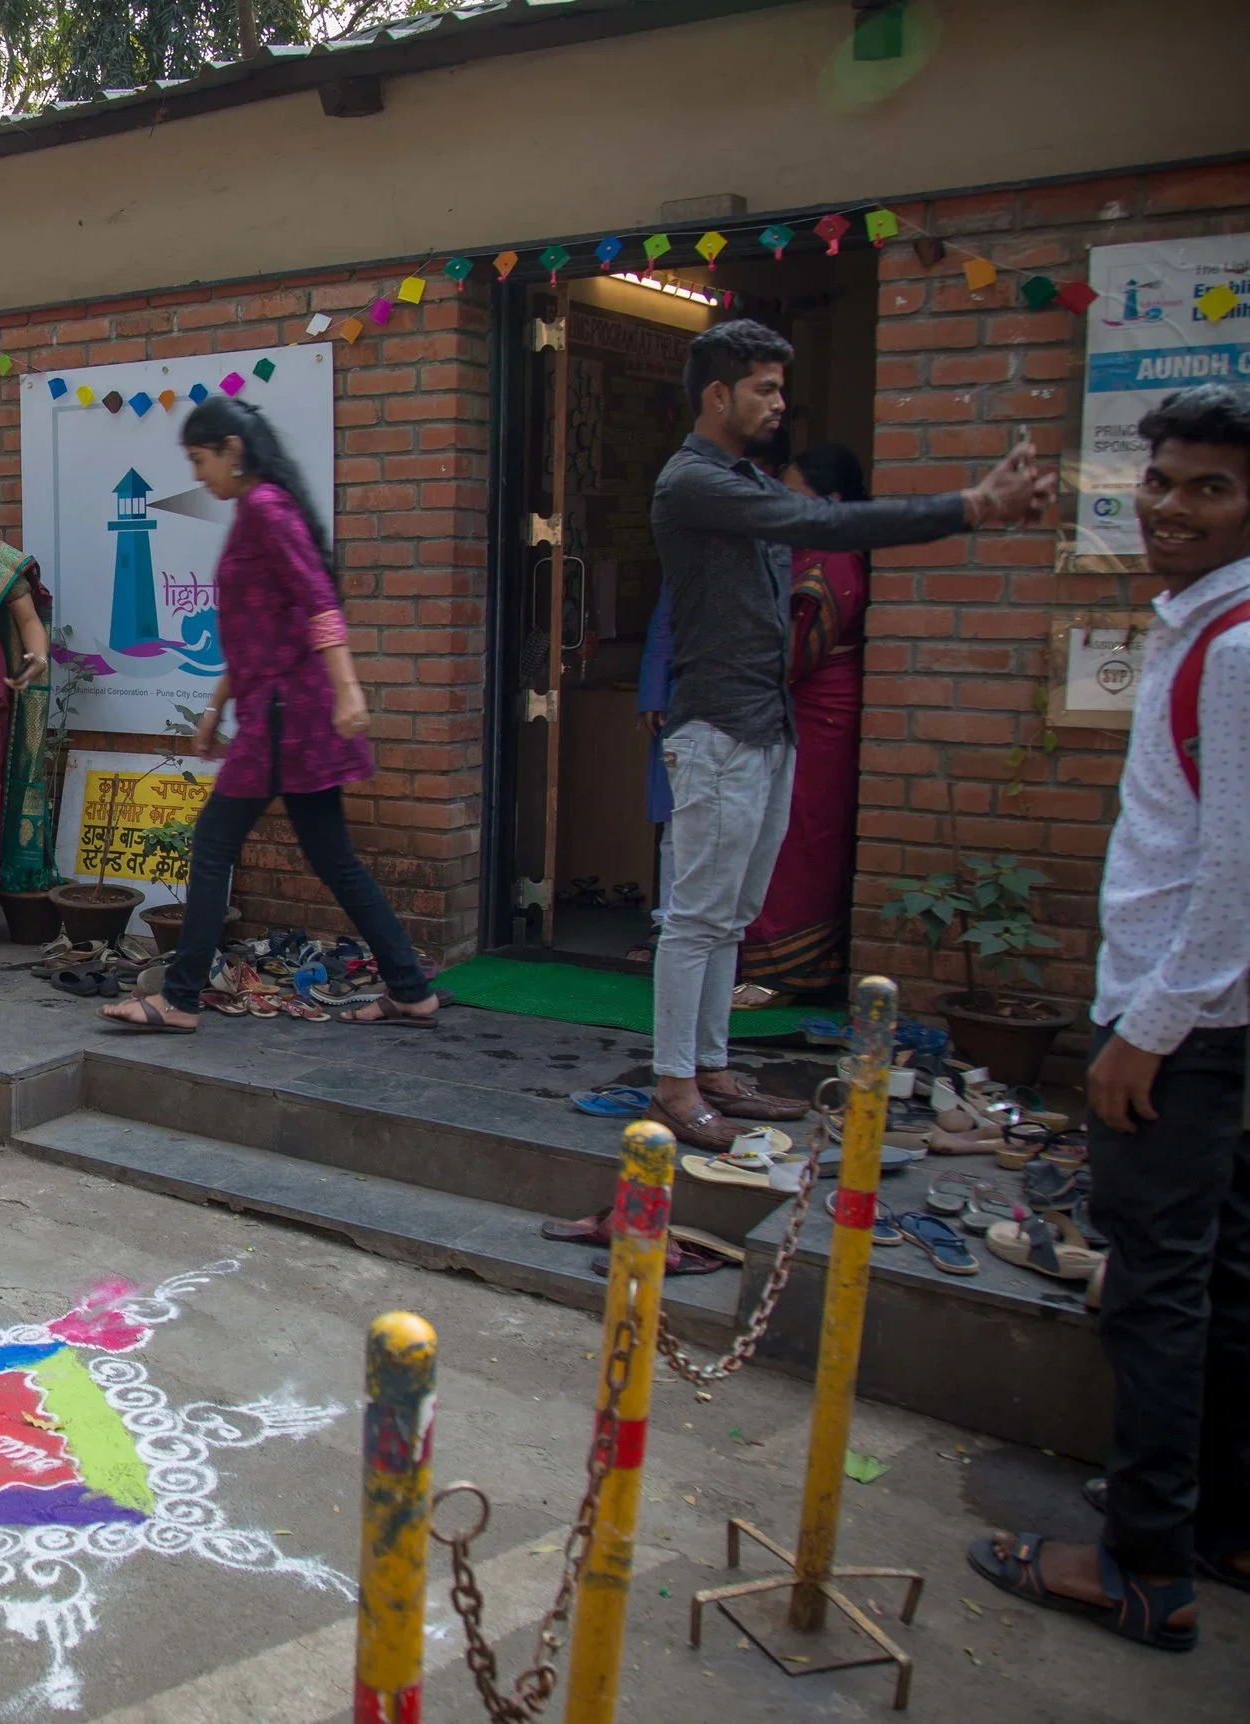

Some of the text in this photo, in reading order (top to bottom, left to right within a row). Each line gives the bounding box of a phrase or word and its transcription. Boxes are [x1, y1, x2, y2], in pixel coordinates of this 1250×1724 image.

[1136, 353, 1230, 380] AUNDH
[161, 571, 220, 617] light
[107, 687, 149, 697] Corporation
[156, 689, 175, 698] Pune
[176, 689, 192, 700] City
[192, 690, 214, 699] Conn
